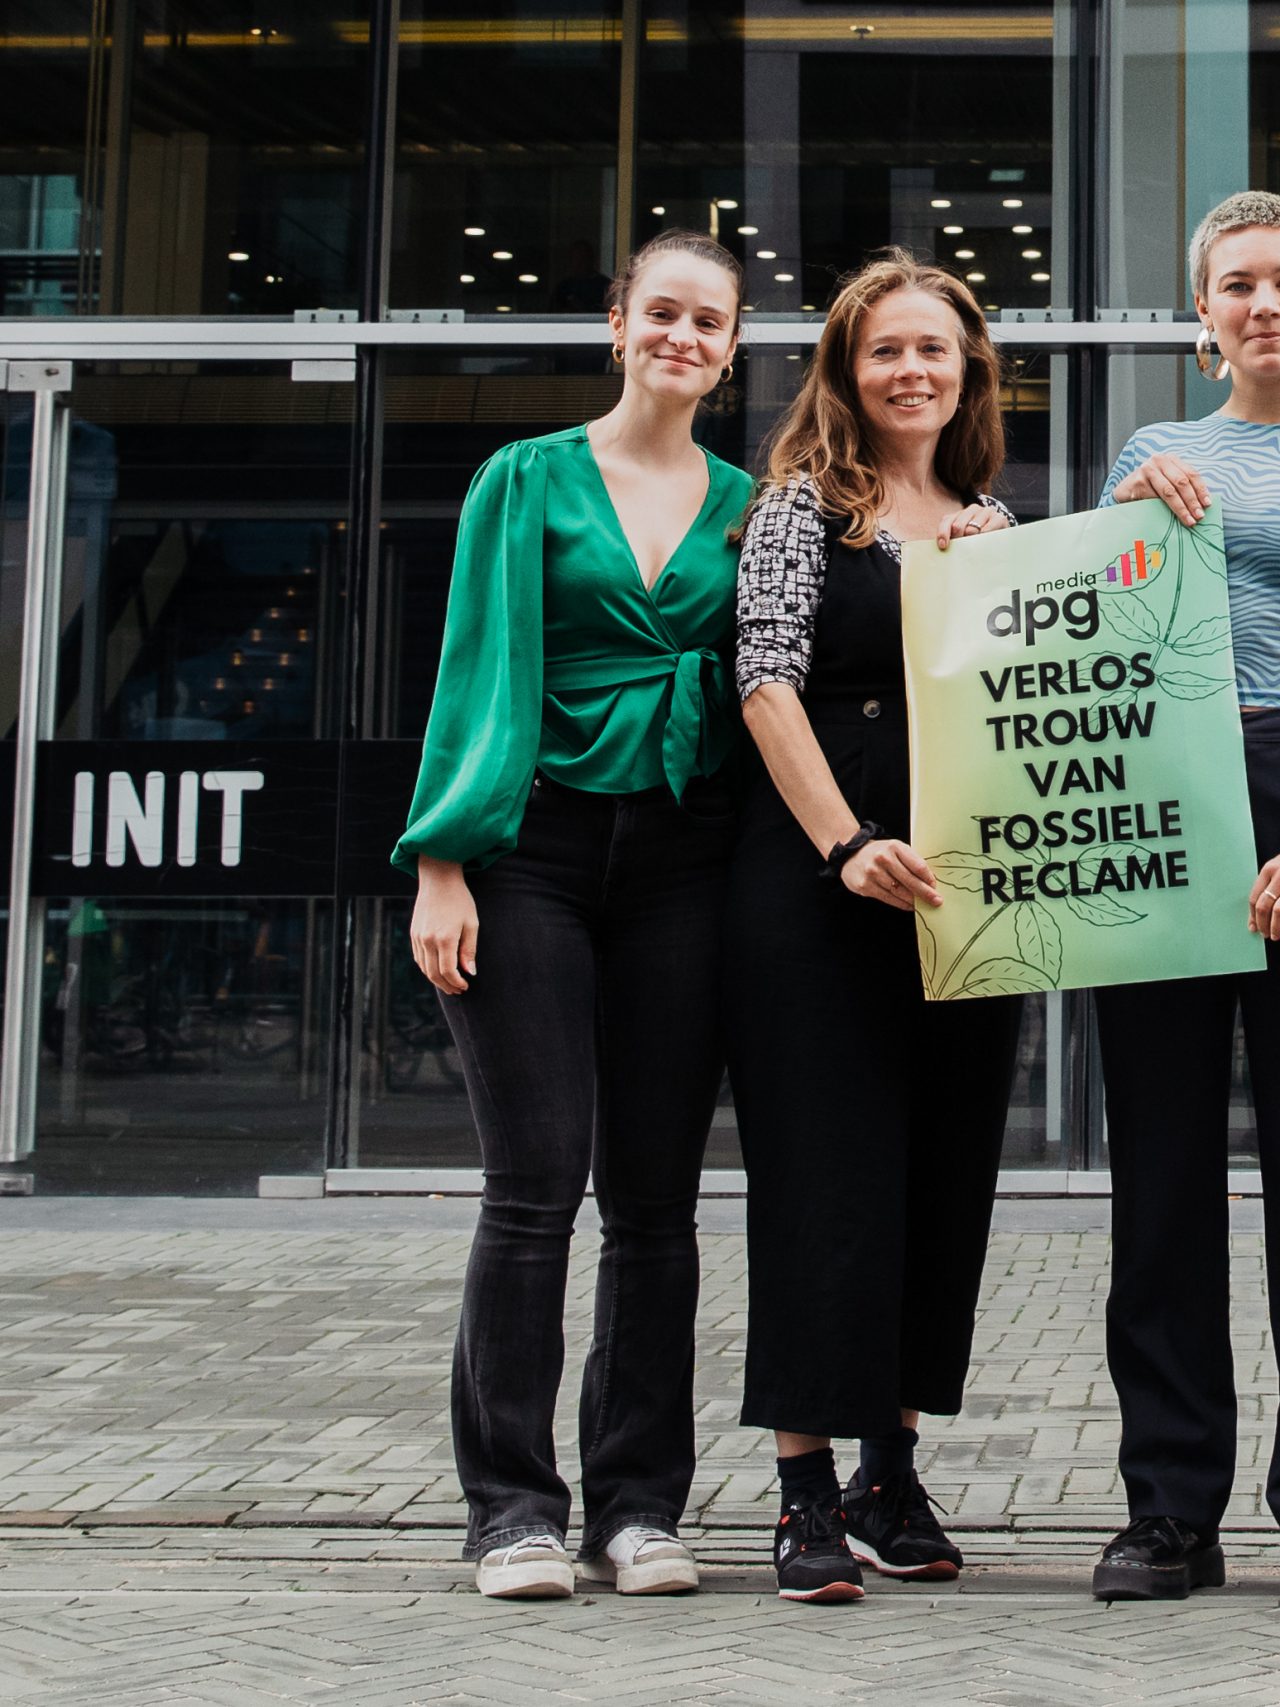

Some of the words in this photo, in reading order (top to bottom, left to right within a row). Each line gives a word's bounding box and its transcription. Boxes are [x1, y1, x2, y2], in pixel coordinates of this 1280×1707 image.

[1036, 572, 1097, 594] media
[986, 588, 1101, 646] dpg
[980, 652, 1157, 703] VERLOS
[986, 702, 1156, 751] TROUW
[1024, 755, 1126, 798] VAN
[72, 771, 265, 868] INIT
[980, 800, 1182, 853] FOSSIELE
[982, 851, 1190, 905] RECLAME
